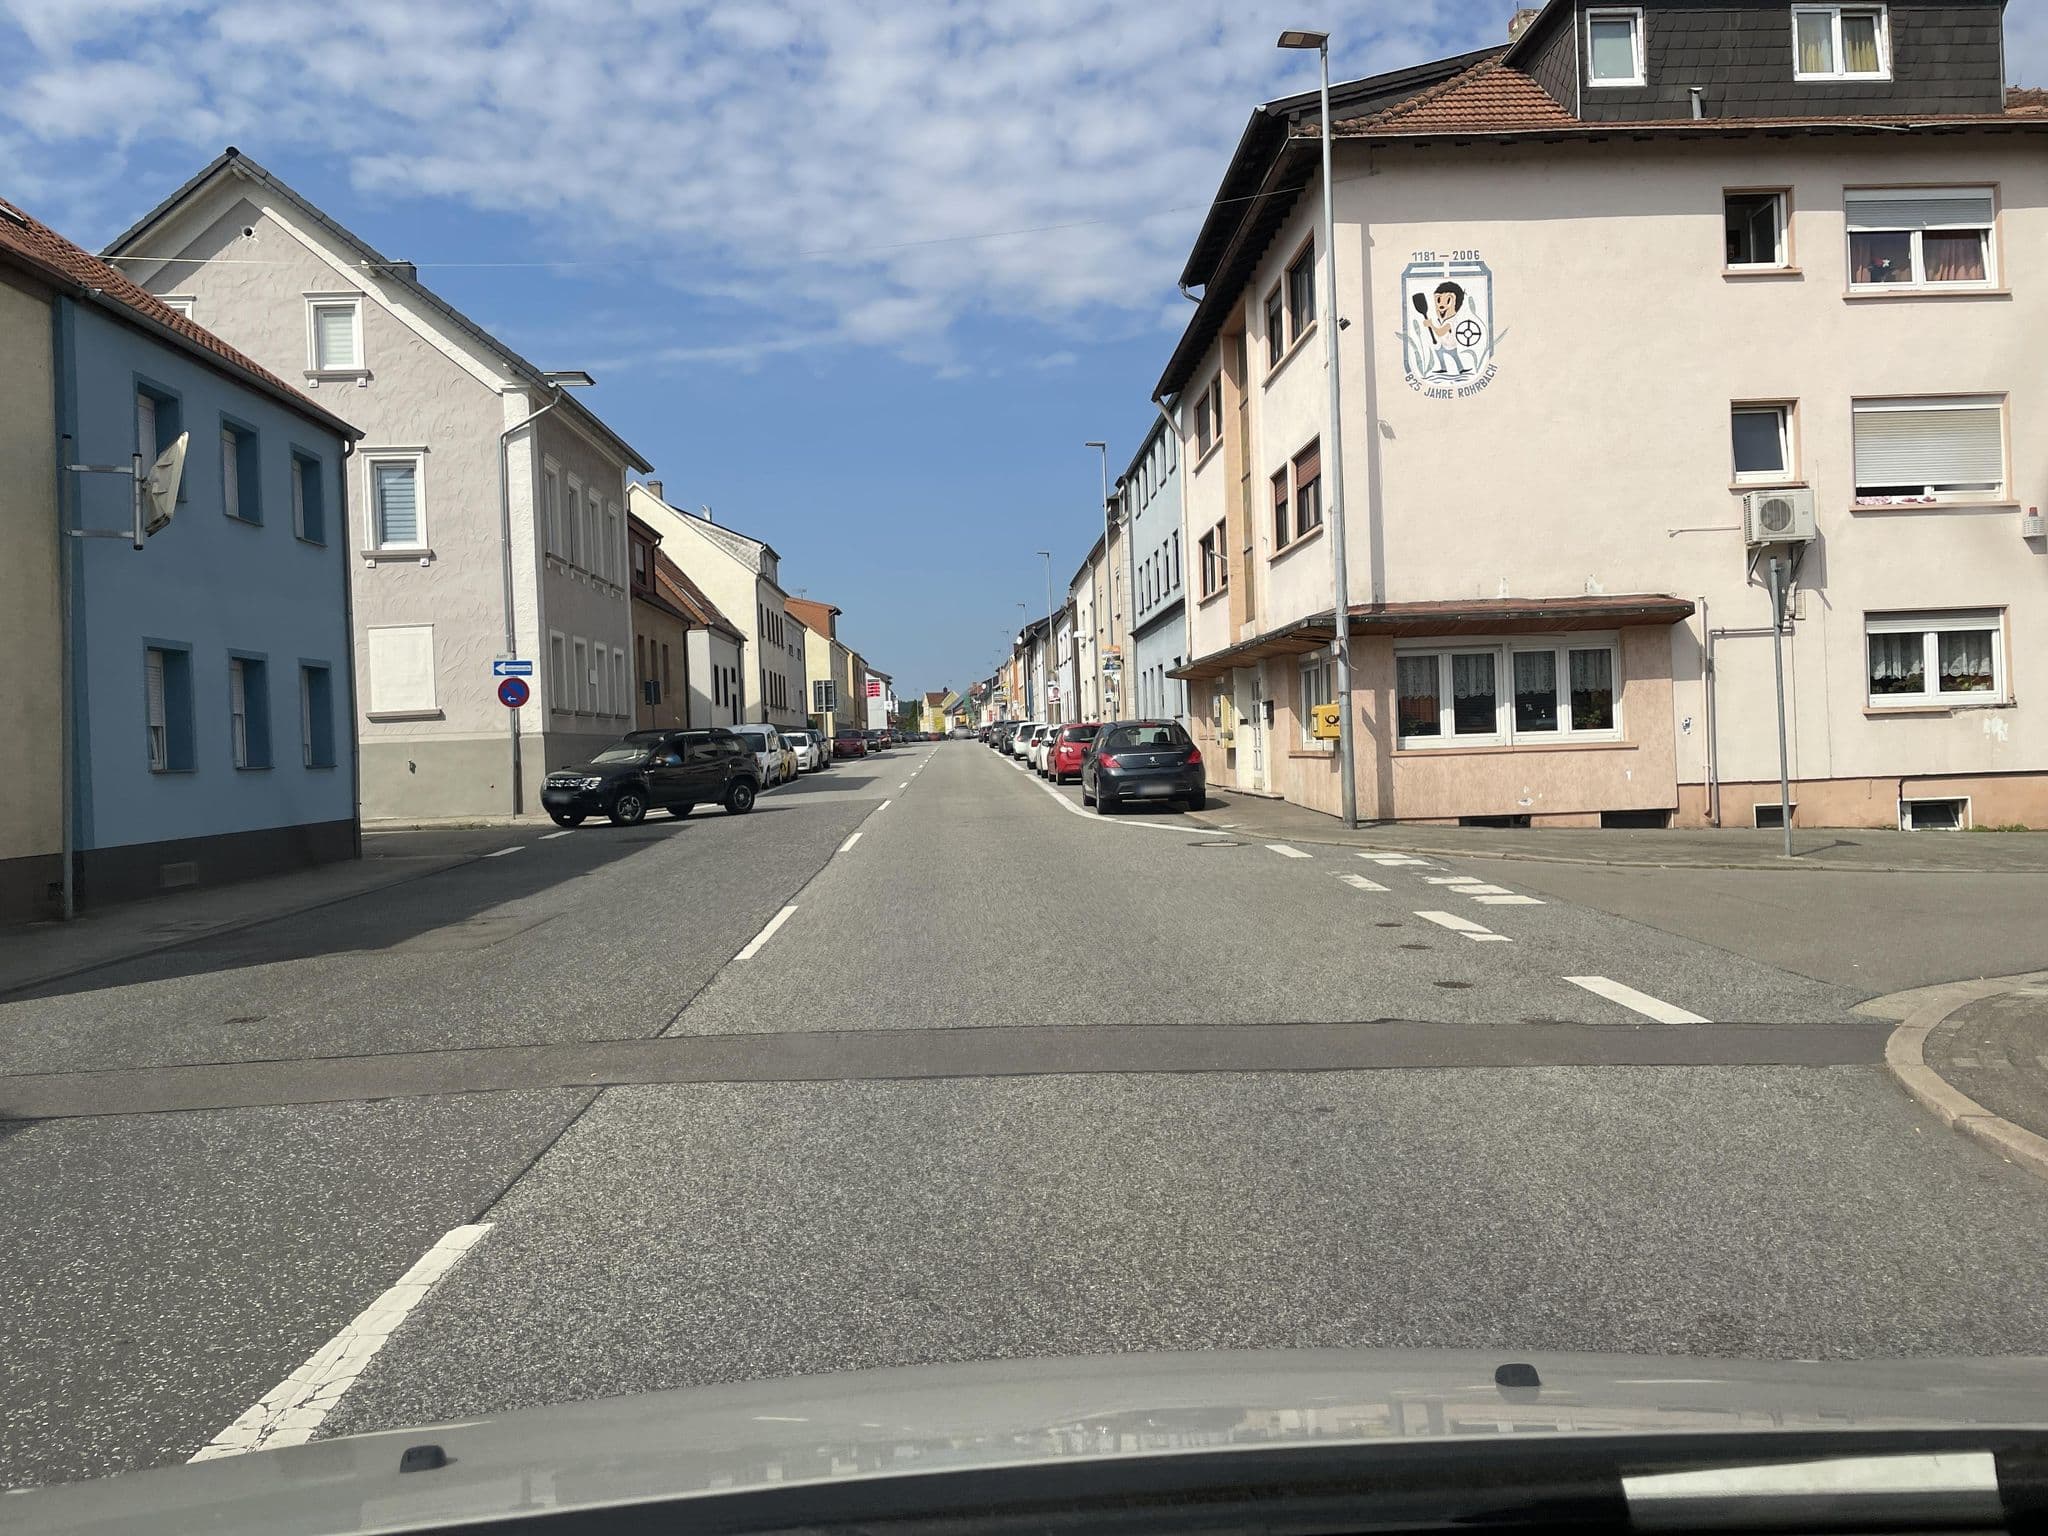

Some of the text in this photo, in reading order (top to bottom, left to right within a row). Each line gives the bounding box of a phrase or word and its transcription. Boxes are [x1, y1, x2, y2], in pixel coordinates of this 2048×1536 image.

[1411, 251, 1436, 261] 1181
[1452, 250, 1480, 260] 2006
[1404, 363, 1498, 399] 825 JAHRE ROHRBACH
